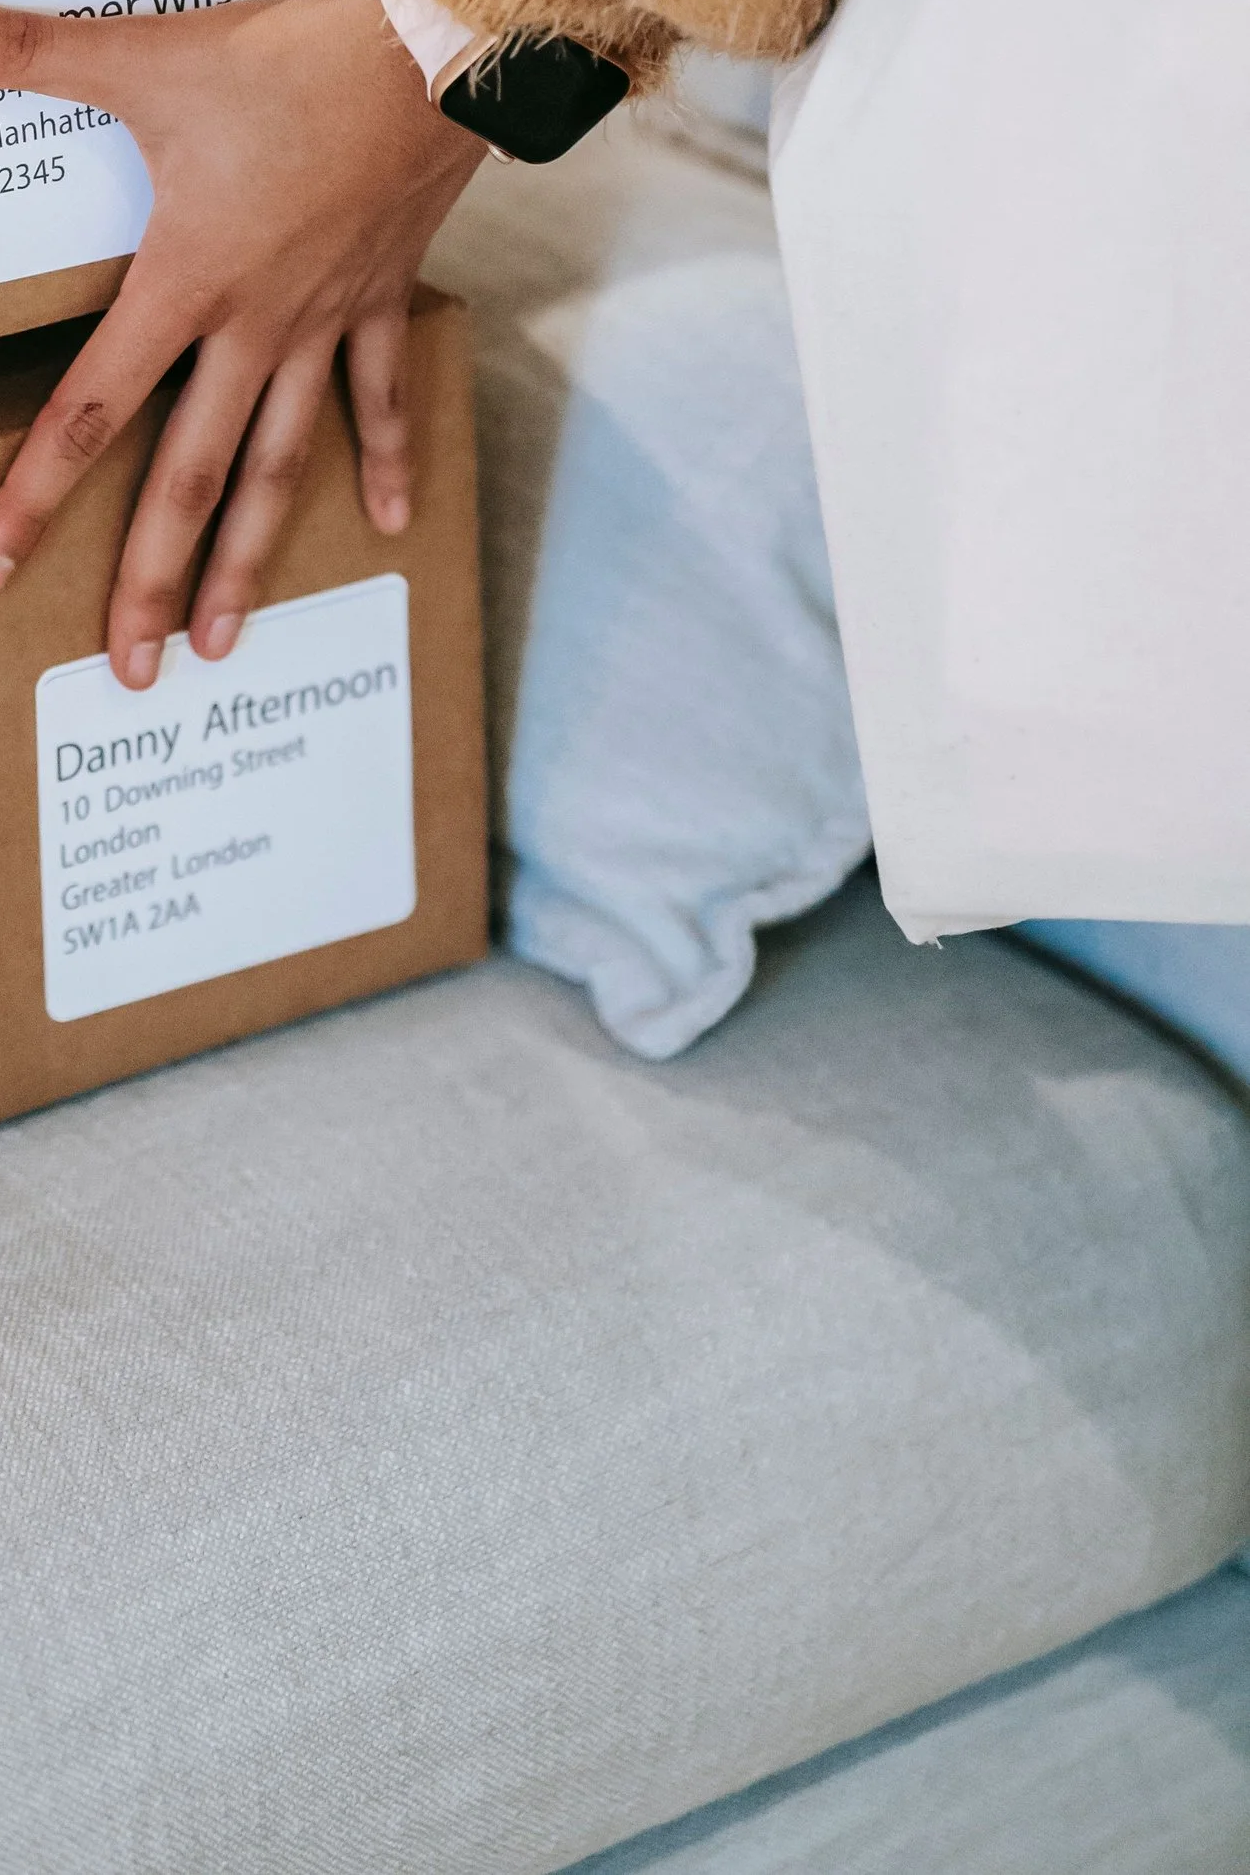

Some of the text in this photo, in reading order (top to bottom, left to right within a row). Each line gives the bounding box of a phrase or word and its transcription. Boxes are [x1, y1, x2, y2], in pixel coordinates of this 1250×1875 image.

[56, 663, 398, 782] Danny Afternoon
[61, 735, 307, 824] 10 Downing Street
[60, 821, 161, 869] London
[61, 832, 272, 912] Greater London
[62, 891, 201, 956] SW1A 2AA
